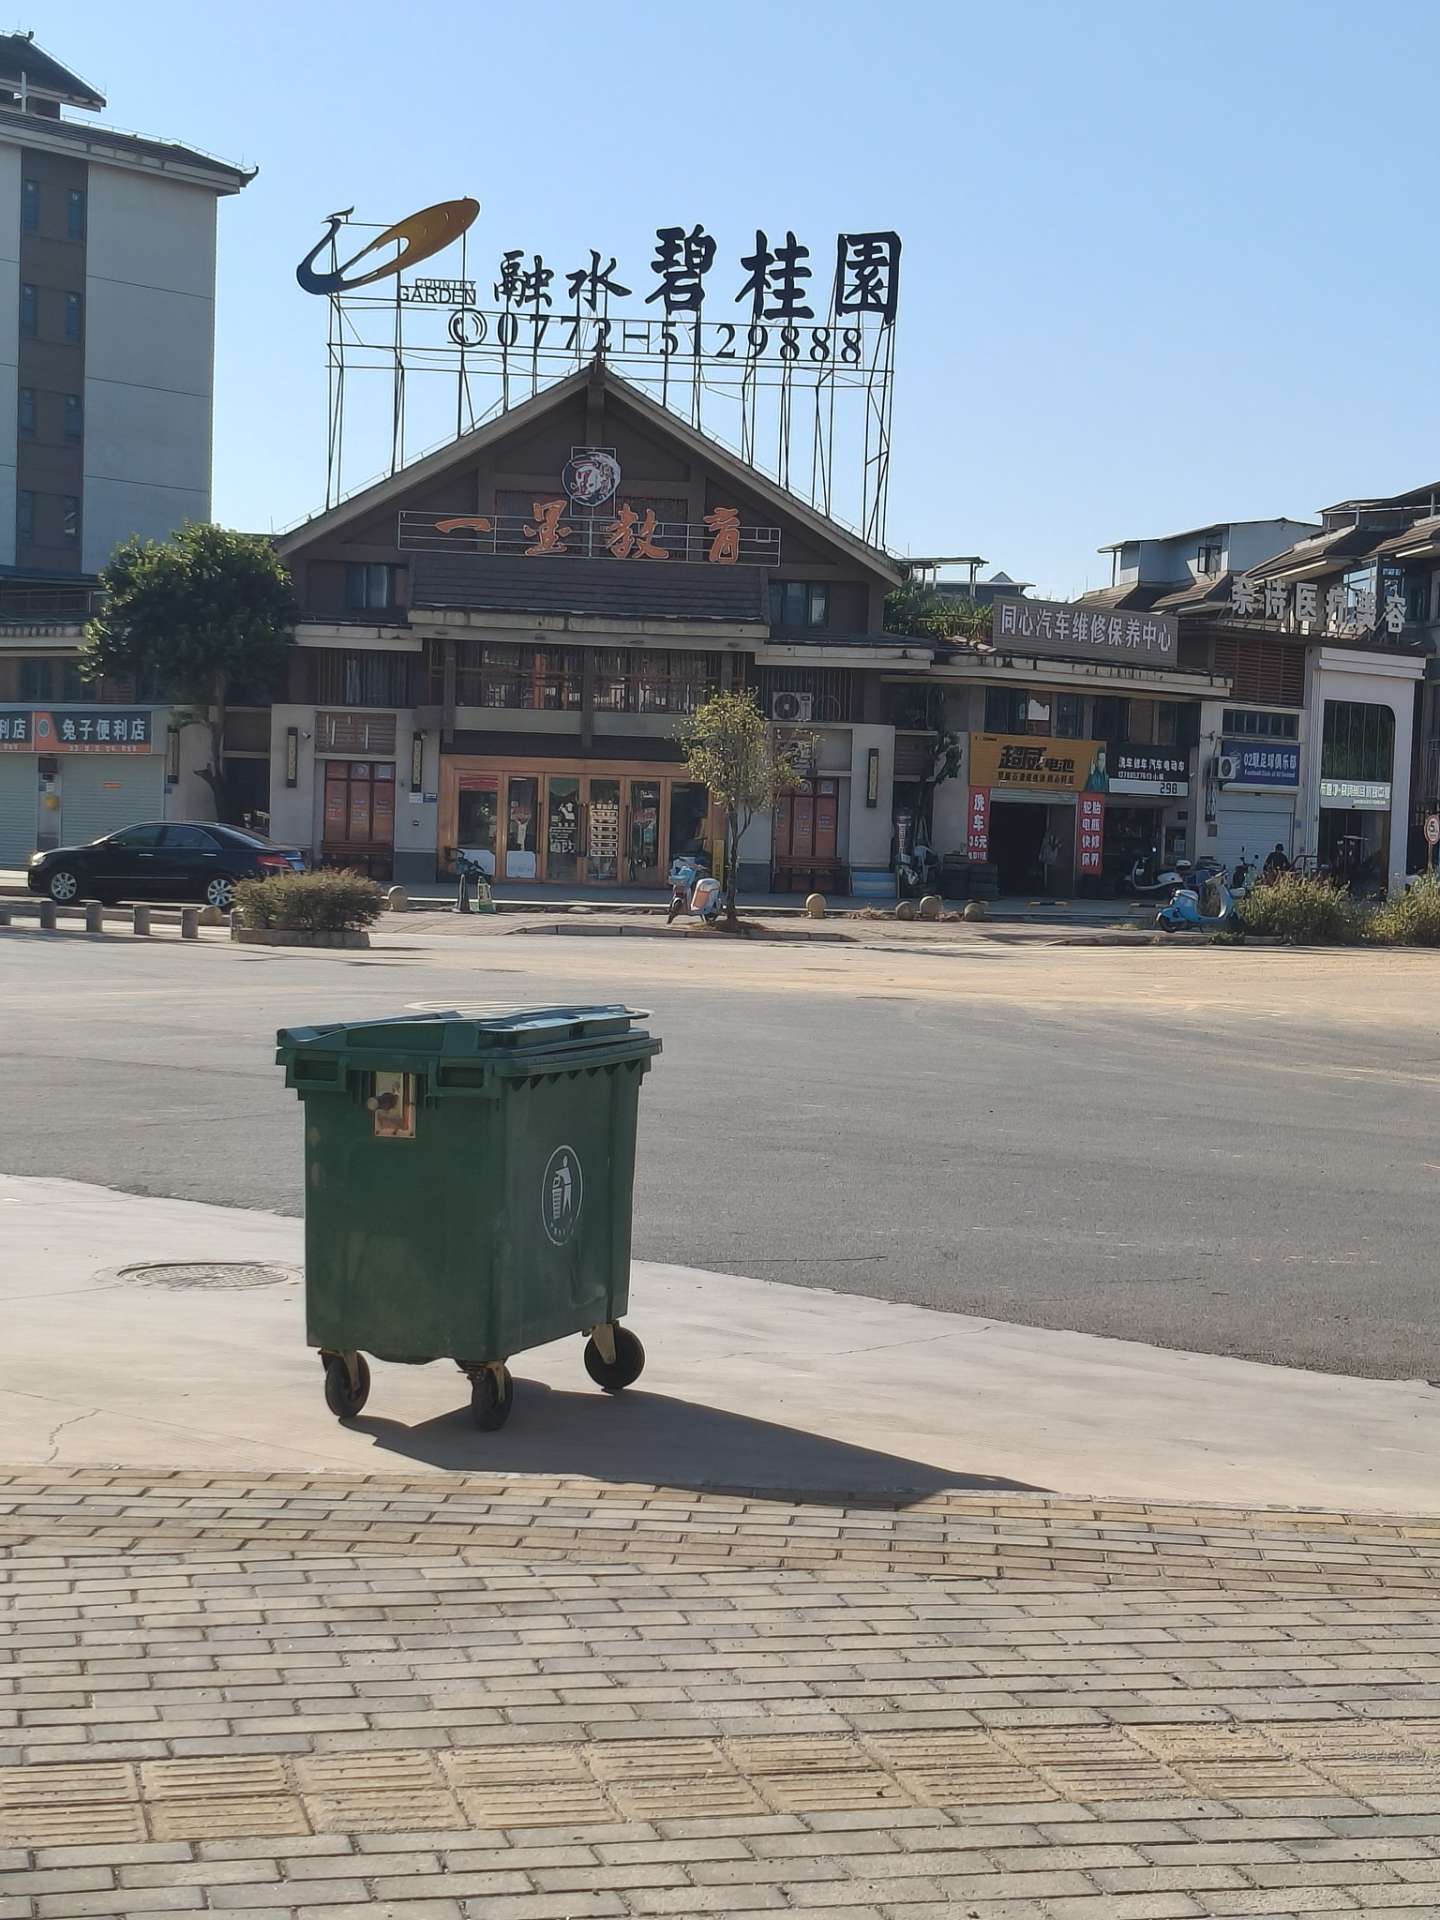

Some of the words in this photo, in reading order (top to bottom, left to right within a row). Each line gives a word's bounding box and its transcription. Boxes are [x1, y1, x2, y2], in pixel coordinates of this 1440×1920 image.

[400, 286, 476, 305] GARDEN
[496, 311, 864, 365] 0772-5129888
[1001, 604, 1172, 652] 同心汽车维修保养中心
[61, 719, 146, 741] 兔子便利店
